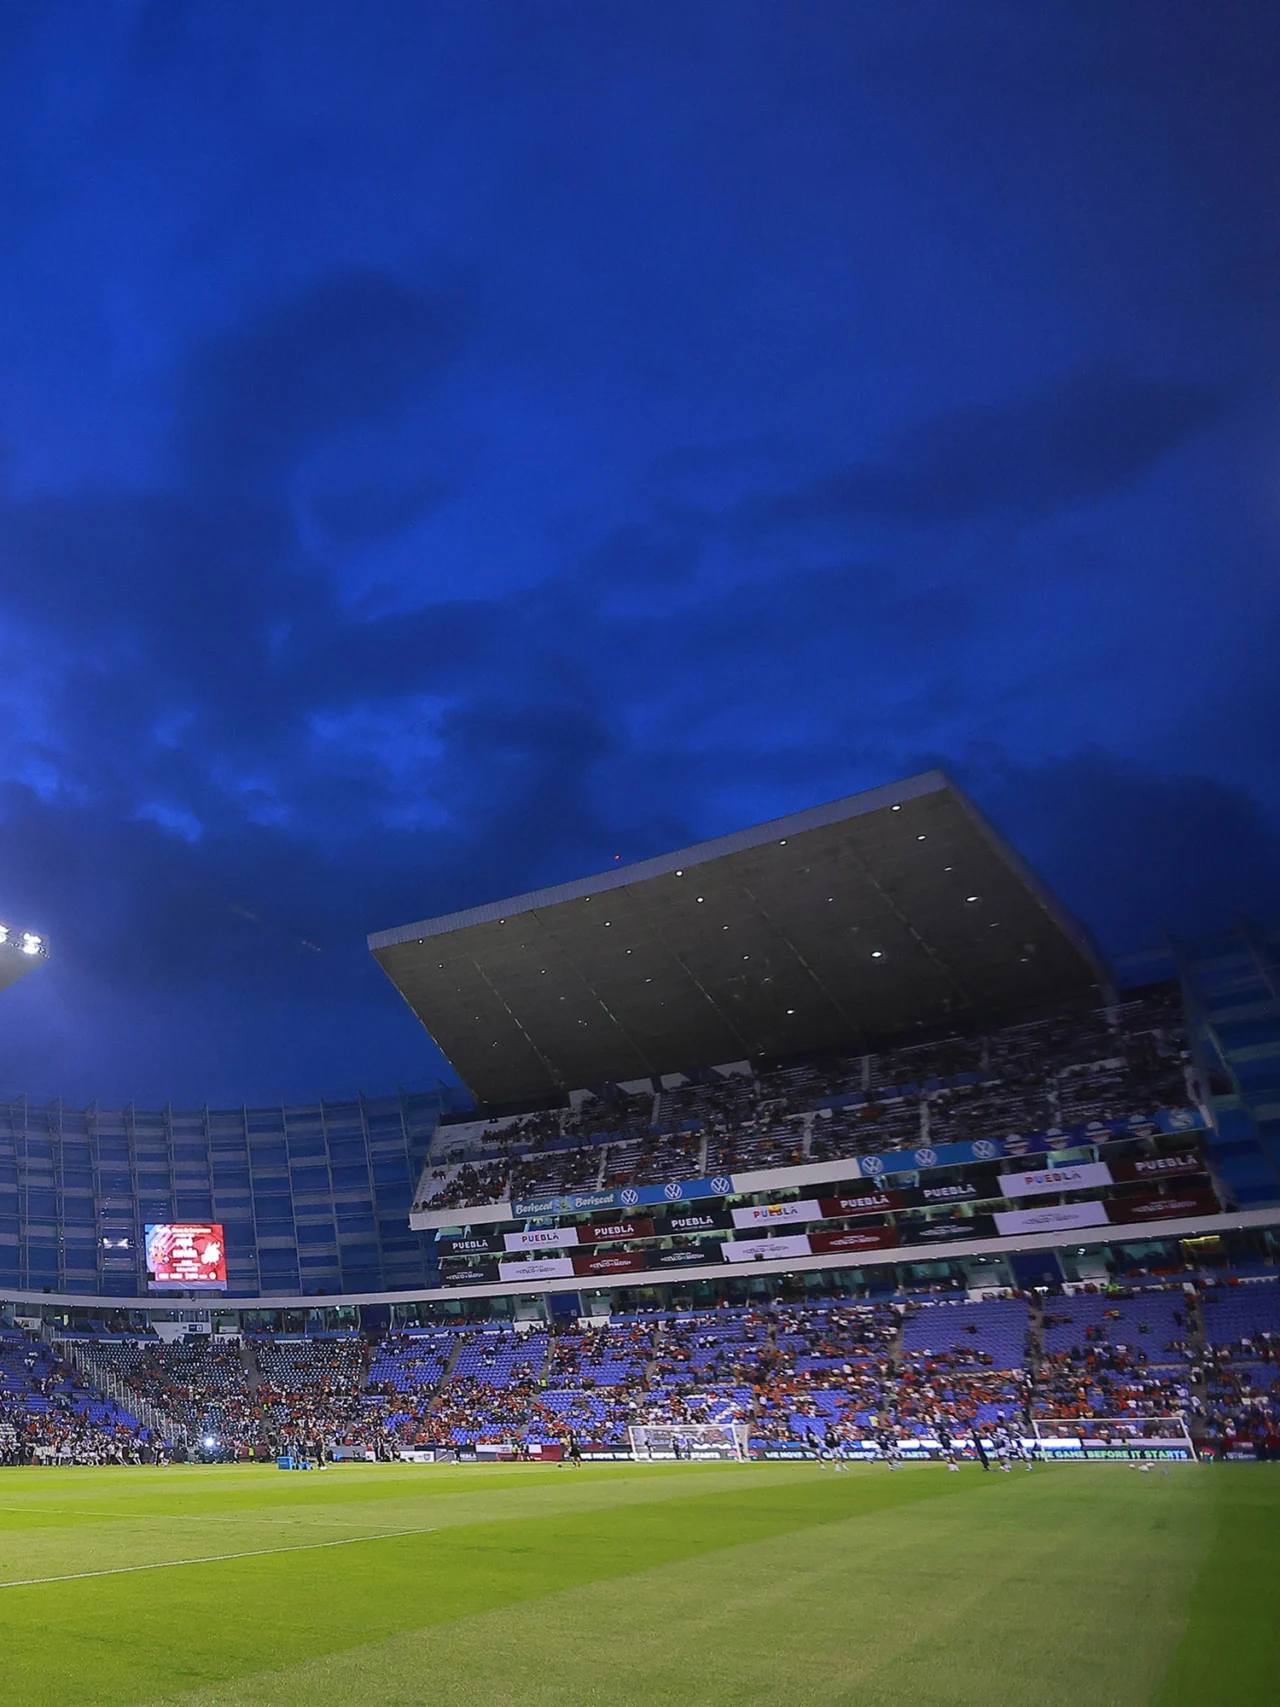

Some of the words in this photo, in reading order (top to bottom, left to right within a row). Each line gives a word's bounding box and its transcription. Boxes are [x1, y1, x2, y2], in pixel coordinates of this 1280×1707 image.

[1054, 1450, 1086, 1459] GAME
[1086, 1450, 1130, 1459] BEFORE
[1130, 1450, 1141, 1459] IT
[1143, 1450, 1188, 1459] STARTS
